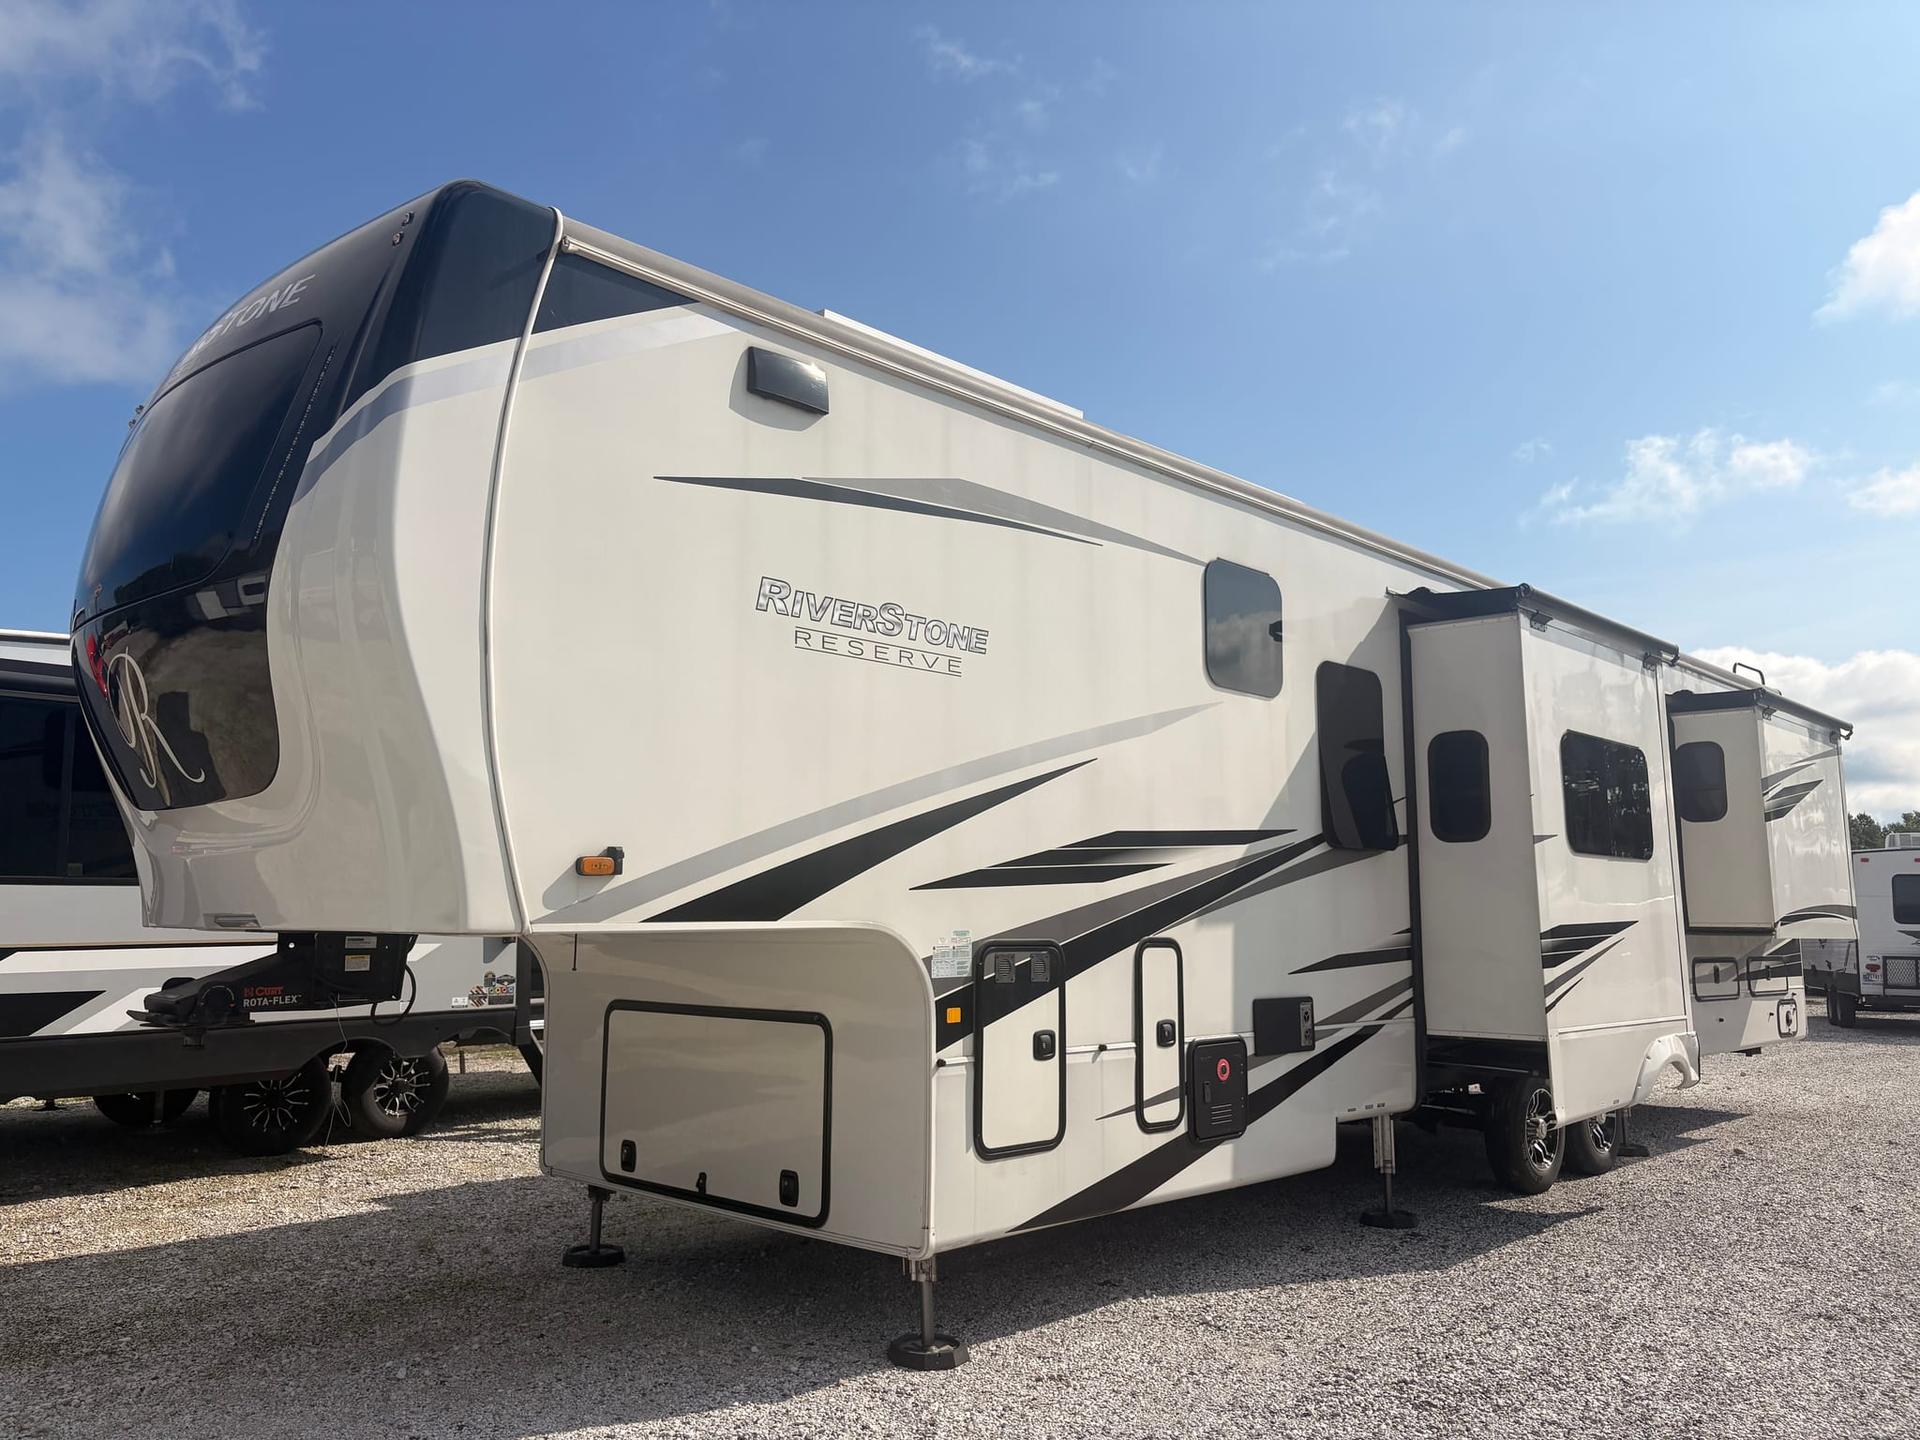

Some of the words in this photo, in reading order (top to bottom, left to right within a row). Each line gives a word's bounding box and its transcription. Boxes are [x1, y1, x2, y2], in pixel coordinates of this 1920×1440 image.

[755, 575, 989, 655] RIVERSTONE
[794, 629, 963, 674] RESERVE
[243, 995, 298, 1008] ROTA-FLEX
